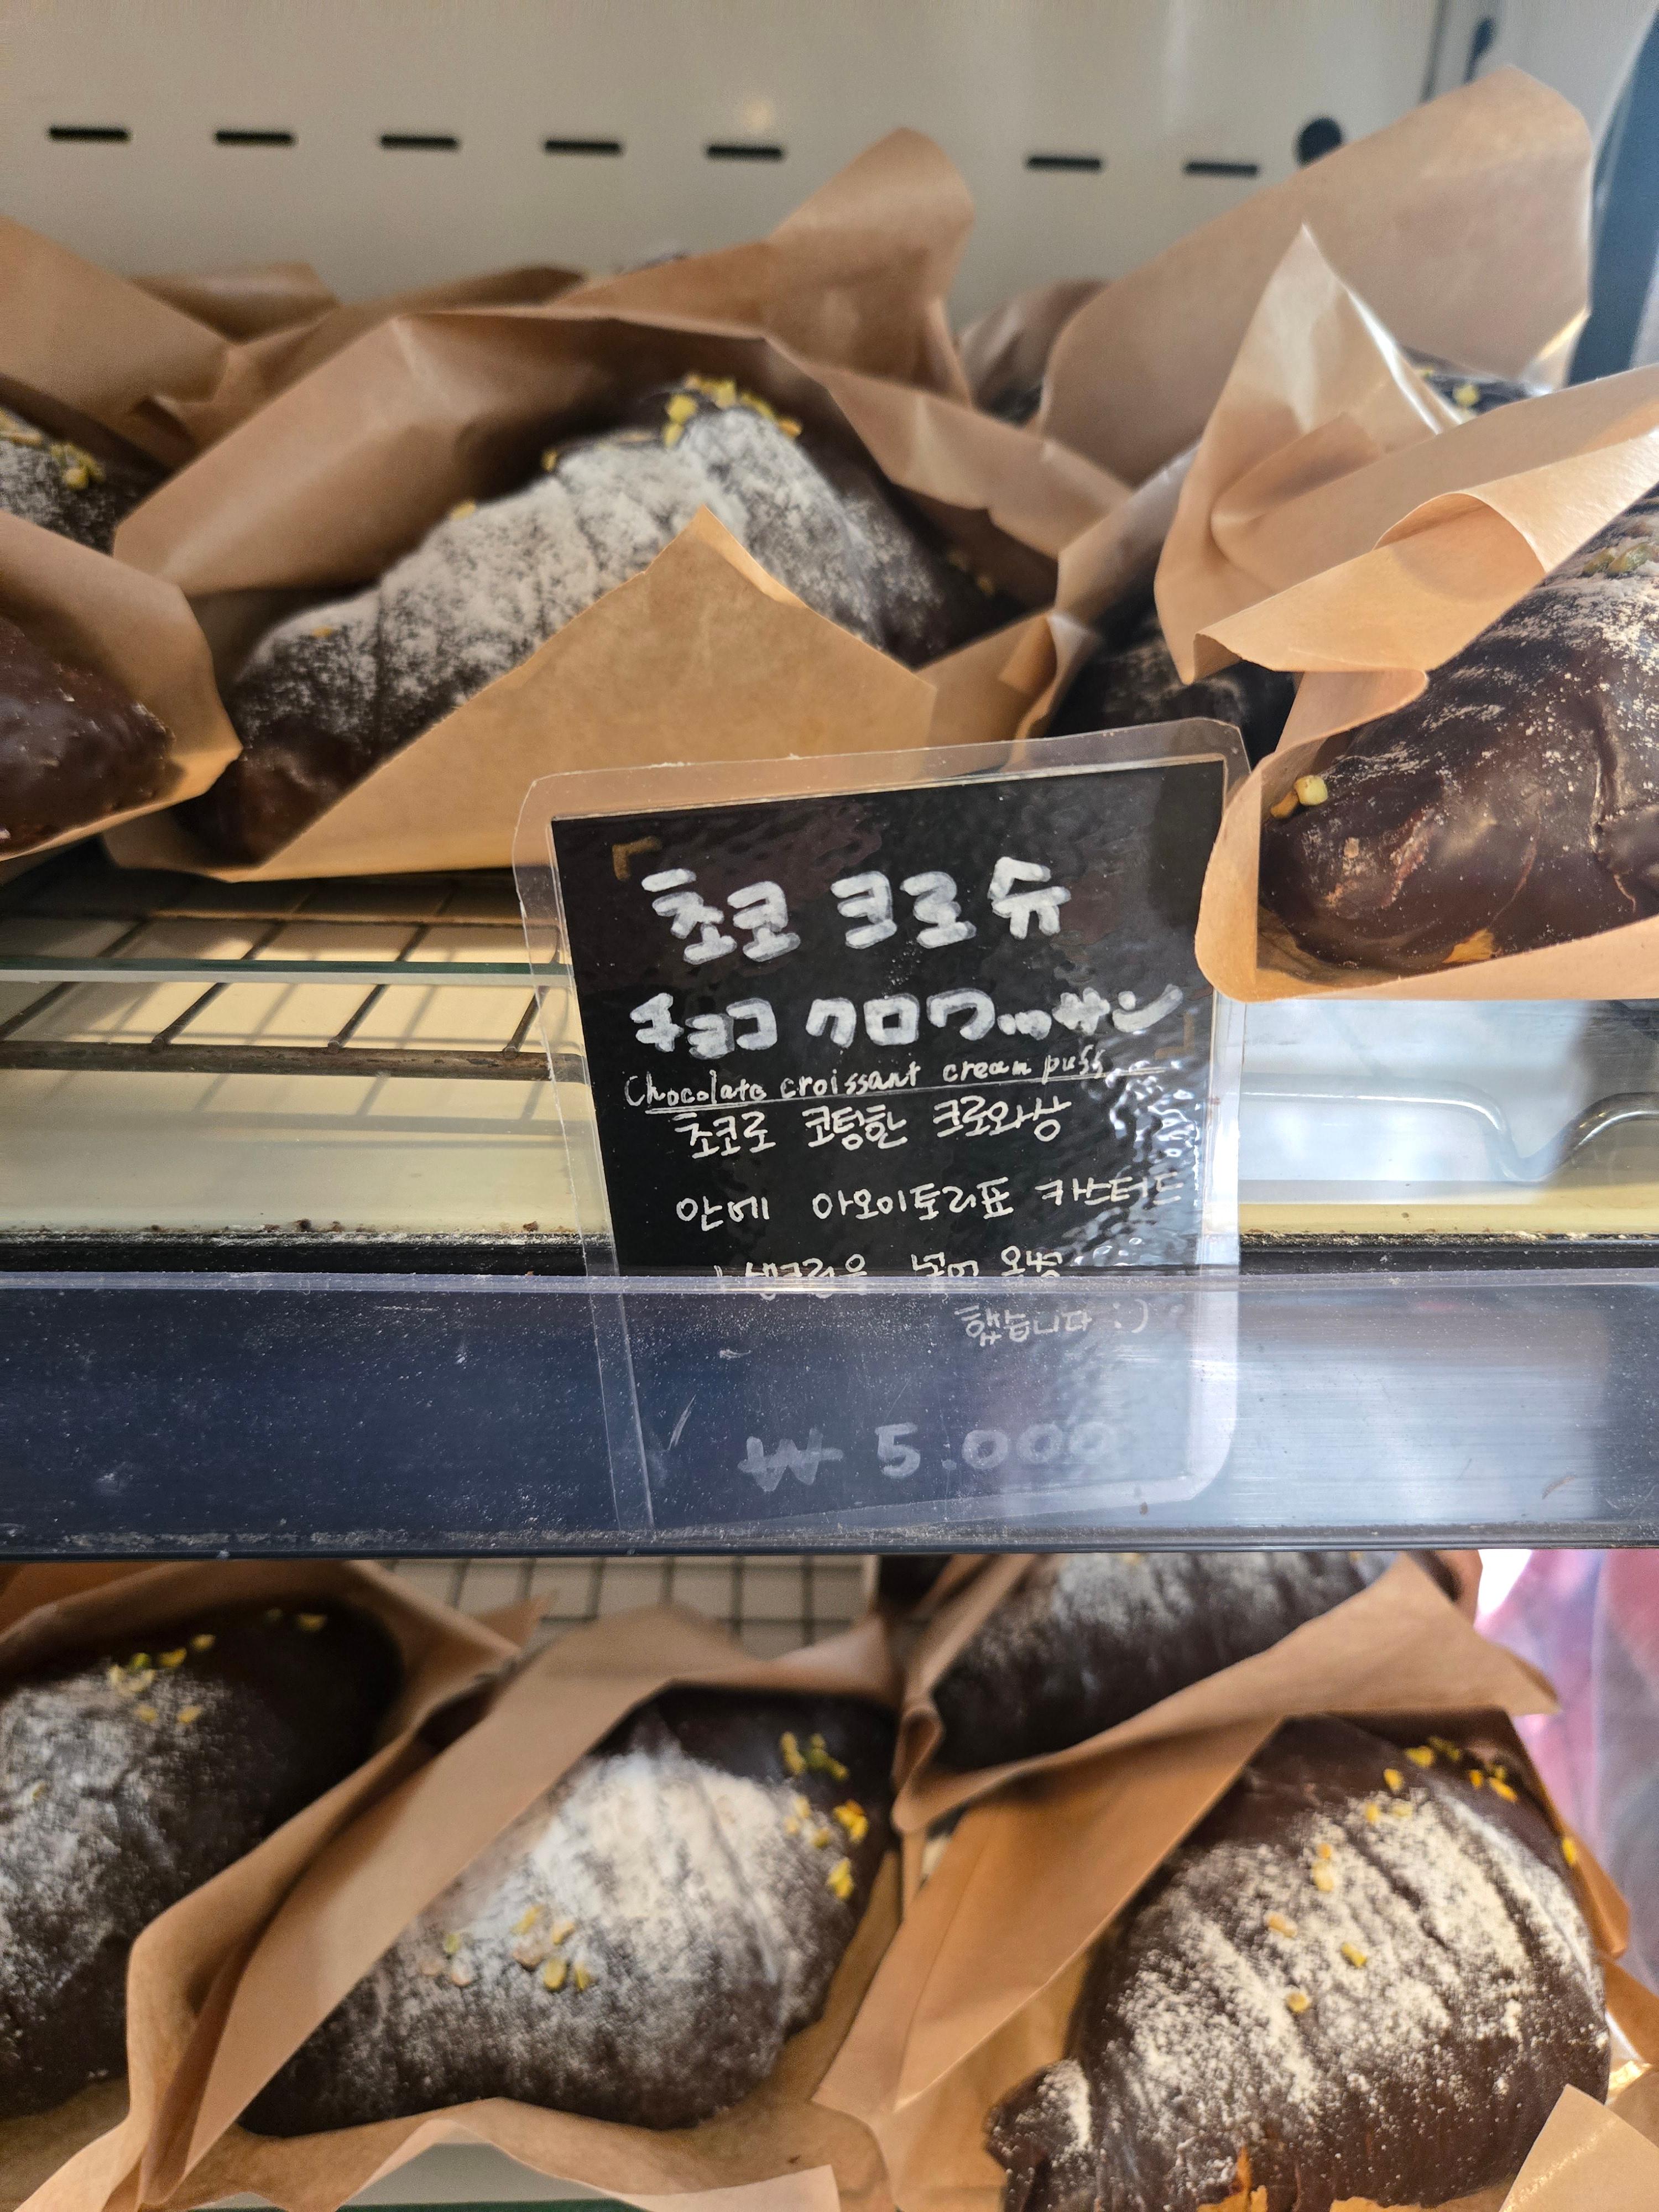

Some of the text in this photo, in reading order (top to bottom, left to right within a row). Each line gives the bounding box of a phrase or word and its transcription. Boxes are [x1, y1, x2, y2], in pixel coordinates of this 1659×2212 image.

[641, 868, 801, 965] 초코
[624, 1070, 766, 1106] Chocolate
[780, 1062, 920, 1099] croissant
[943, 1060, 1031, 1082] cream
[672, 1112, 776, 1158] 초코로
[933, 1095, 1072, 1141] 크로와상
[676, 1196, 770, 1232] 안에
[812, 1177, 1014, 1220] 아오이토리표
[954, 1305, 1092, 1346] 했습니다
